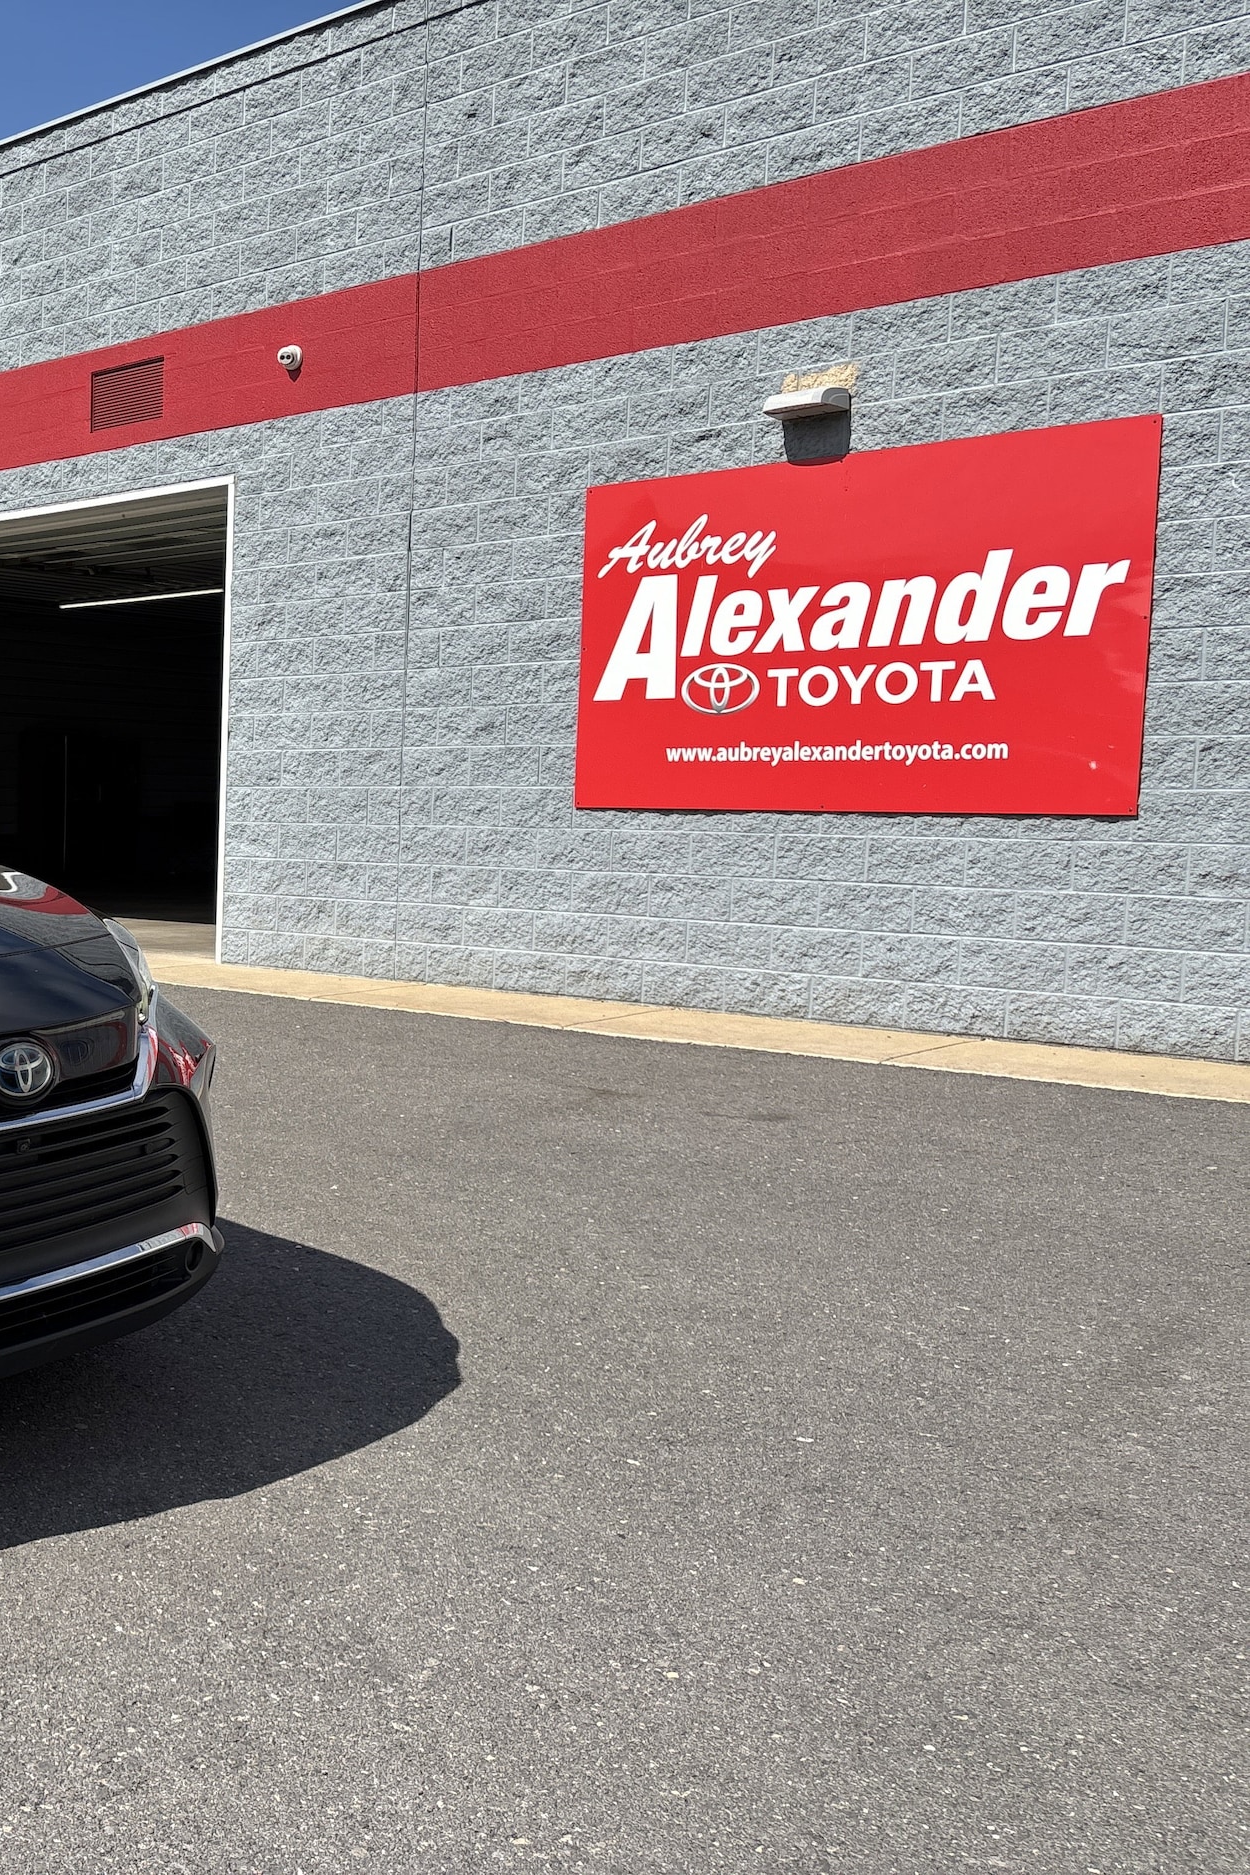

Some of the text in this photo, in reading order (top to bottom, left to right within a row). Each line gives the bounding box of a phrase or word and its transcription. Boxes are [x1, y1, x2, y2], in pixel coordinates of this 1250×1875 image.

[598, 514, 777, 578] Aubrey
[592, 549, 1131, 702] Alexander
[767, 660, 996, 707] TOYOTA
[666, 739, 1009, 767] www.aubreyalexandertoyota.com
